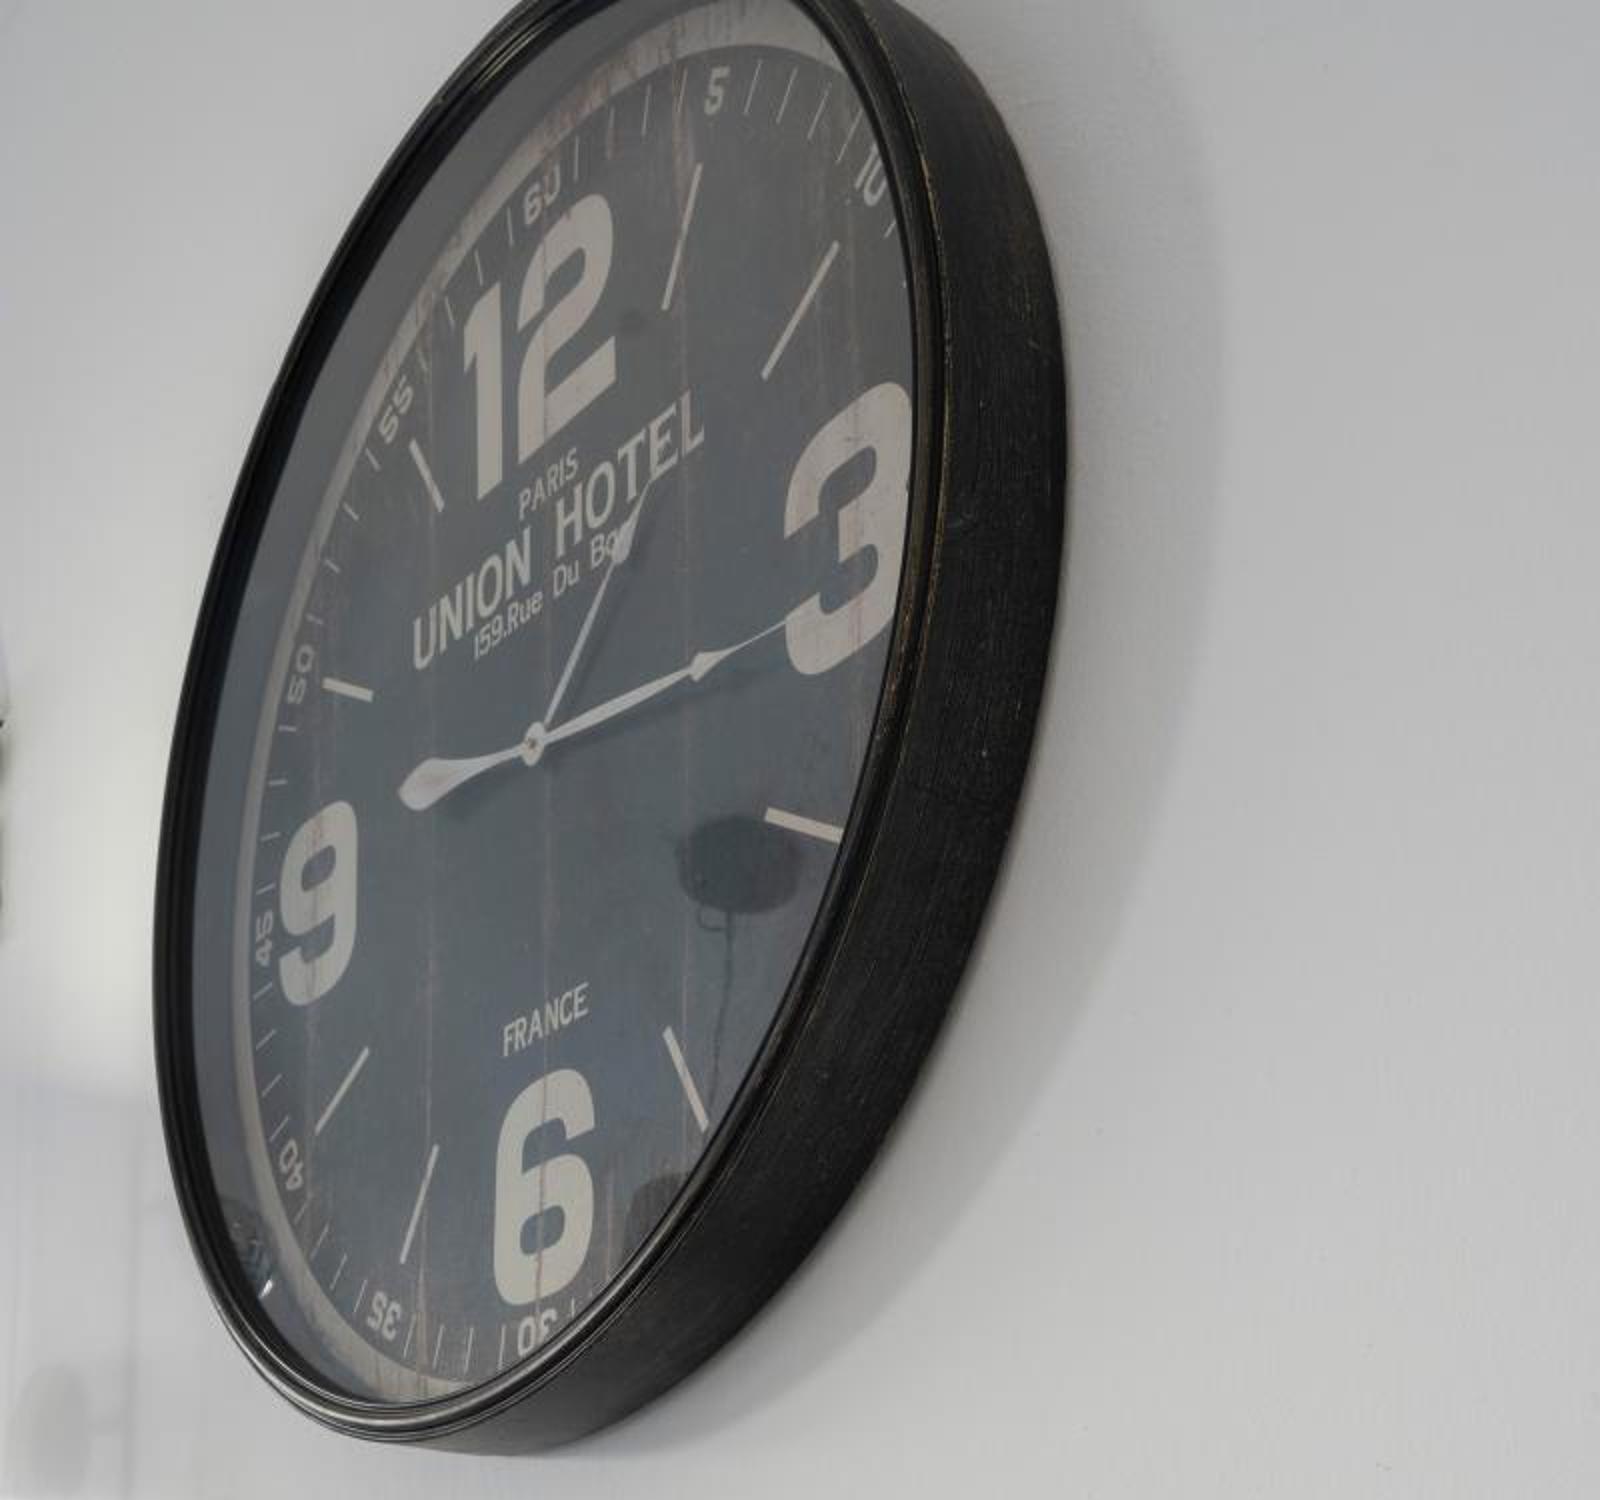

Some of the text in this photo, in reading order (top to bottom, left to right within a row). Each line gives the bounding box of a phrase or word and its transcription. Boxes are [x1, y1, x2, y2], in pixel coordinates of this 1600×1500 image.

[703, 66, 731, 116] 5
[523, 163, 562, 226] 60
[854, 141, 888, 207] 10
[463, 193, 617, 500] 12
[378, 375, 415, 445] 55
[518, 446, 579, 522] PARIS
[413, 388, 705, 670] UNION HOTEL
[783, 381, 914, 676] 3
[552, 559, 580, 599] Du
[287, 645, 316, 705] 50
[278, 800, 358, 1007] 9
[254, 909, 274, 968] 45
[502, 980, 590, 1058] FRANCE
[278, 1137, 304, 1192] 40
[493, 1067, 596, 1307] 6
[366, 1290, 402, 1342] 35
[516, 1307, 558, 1358] 30
